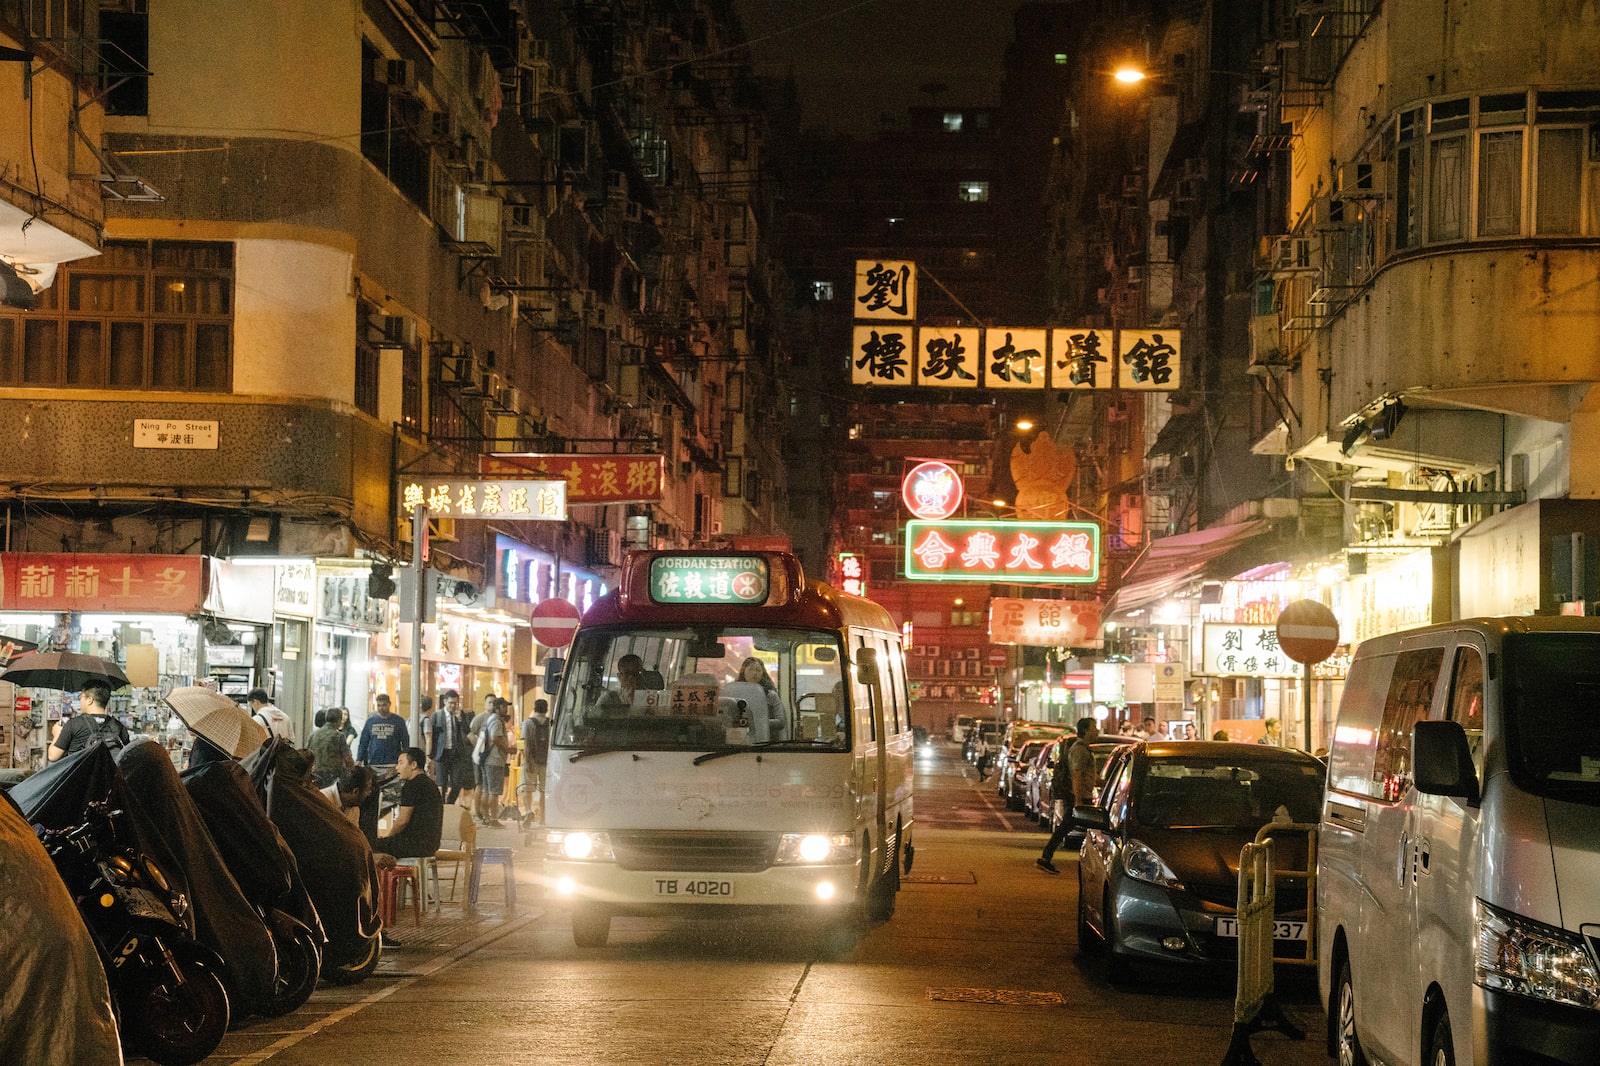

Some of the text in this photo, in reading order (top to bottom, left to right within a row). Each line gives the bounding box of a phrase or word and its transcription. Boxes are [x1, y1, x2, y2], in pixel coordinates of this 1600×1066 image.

[857, 263, 910, 316] 劉
[855, 330, 1177, 388] 標跌打醫館
[140, 422, 212, 432] Ning Po Street
[658, 557, 761, 570] JORDAN STATION
[913, 530, 1092, 571] 合興火鍋
[19, 564, 186, 600] 莉莉士多
[658, 571, 732, 599] 佐敦道
[655, 879, 731, 896] TB 4020
